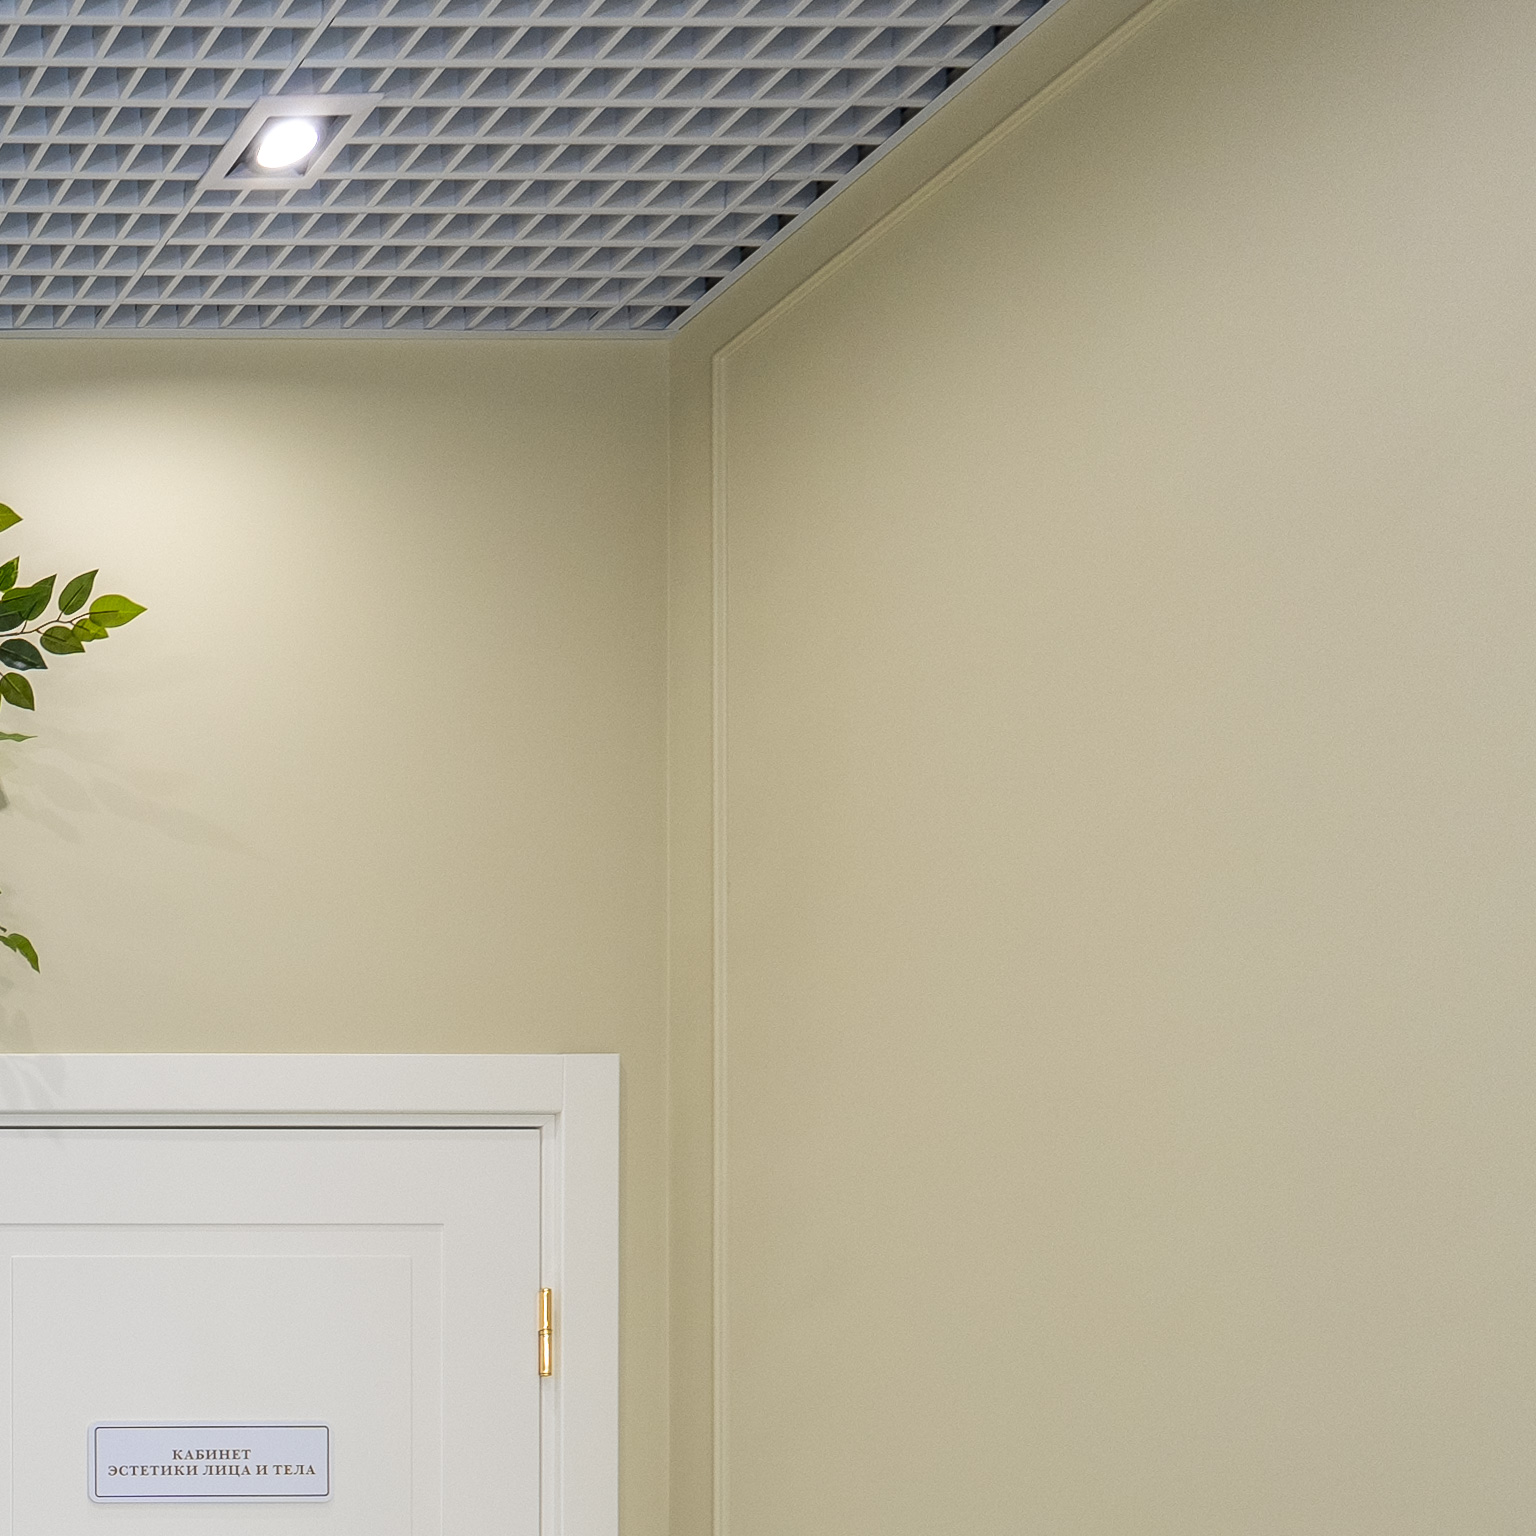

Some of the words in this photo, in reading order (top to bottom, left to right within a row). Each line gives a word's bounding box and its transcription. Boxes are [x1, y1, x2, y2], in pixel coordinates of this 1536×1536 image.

[171, 1449, 251, 1460] КАБИНЕТ
[107, 1465, 197, 1476] ЭСТЕТИКИ
[202, 1464, 251, 1477] ЛИЦА
[256, 1465, 268, 1476] И
[273, 1464, 316, 1476] ТЕЛА
